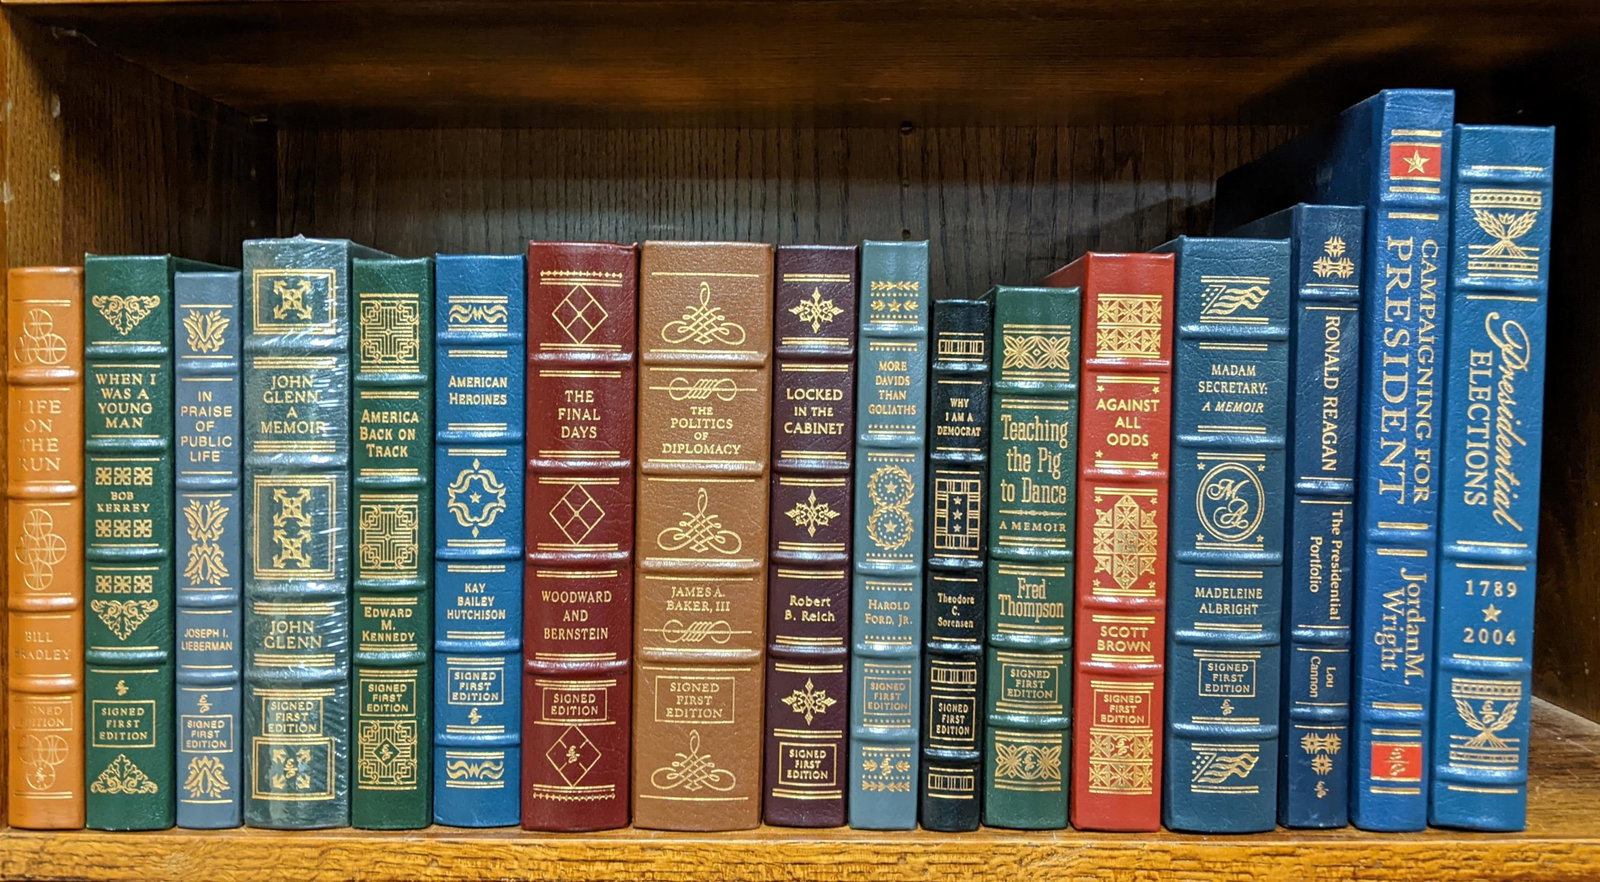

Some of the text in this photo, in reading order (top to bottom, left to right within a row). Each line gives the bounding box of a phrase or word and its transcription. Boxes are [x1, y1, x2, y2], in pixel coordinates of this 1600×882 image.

[879, 361, 907, 372] MORE
[1211, 365, 1256, 377] MADAM
[1379, 236, 1413, 505] PRESIDENT
[1413, 239, 1439, 503] CAMPAIGNING FOR
[96, 374, 156, 385] WHEN I
[271, 375, 314, 390] JOHN
[448, 376, 508, 388] AMERICAN
[875, 375, 910, 386] DAVIDS
[101, 388, 149, 400] WAS A
[1198, 382, 1268, 395] SECRETARY:
[1321, 315, 1341, 472] RONALD REAGAN
[198, 391, 212, 402] IN
[263, 391, 319, 404] GLENN
[449, 393, 507, 405] HEROINES
[564, 390, 594, 403] THE
[786, 388, 843, 401] LOCKED
[879, 390, 907, 400] THAN
[98, 403, 153, 414] YOUNG
[950, 398, 969, 408] WHY
[1096, 399, 1160, 412] AGAINST
[1202, 402, 1264, 413] A MEMOIR
[181, 406, 233, 417] PRAISE
[286, 406, 298, 418] A
[558, 408, 601, 421] FINAL
[690, 406, 713, 416] THE
[794, 407, 834, 417] IN THE
[868, 404, 917, 415] GOLIATHS
[361, 409, 419, 424] AMERICA
[945, 412, 974, 422] I AM A
[1485, 311, 1531, 532] Presidential
[24, 419, 52, 432] ON
[105, 417, 143, 429] MAN
[195, 421, 215, 432] OF
[261, 421, 327, 434] MEMOIR
[670, 418, 733, 429] POLITICS
[784, 422, 844, 435] CABINET
[1115, 417, 1141, 429] ALL
[1464, 349, 1493, 506] ELECTIONS
[360, 427, 416, 440] BACK ON
[561, 426, 597, 439] DAYS
[694, 432, 708, 440] OF
[937, 425, 981, 437] DEMOCRAT
[1001, 414, 1068, 449] Teaching
[181, 436, 232, 448] PUBLIC
[1106, 433, 1149, 447] ODDS
[366, 444, 408, 457] TRACK
[662, 443, 741, 455] DIPLOMACY
[190, 451, 221, 463] LIFE
[1006, 446, 1061, 480] the Pig
[111, 492, 134, 500] BOB
[1001, 477, 1067, 504] to Dance
[97, 504, 150, 513] KERREY
[999, 521, 1067, 532] A MEMOIR
[1310, 535, 1323, 593] Portfolio
[1329, 509, 1344, 621] The Presidential
[464, 583, 486, 593] KAY
[671, 587, 726, 598] JAMES A.
[1017, 578, 1046, 600] Fred
[1195, 587, 1263, 599] MADELEINE
[1465, 580, 1517, 597] 1789
[457, 596, 494, 607] BAILEY
[541, 590, 612, 603] WOODWARD
[789, 595, 831, 607] Robert
[937, 593, 975, 604] Theodore
[666, 600, 730, 613] BAKER, III
[868, 599, 910, 611] HAROLD
[998, 594, 1064, 623] Thompson
[1199, 603, 1258, 615] ALBRIGHT
[364, 607, 413, 618] EDWARD
[447, 609, 506, 620] HUTCHISON
[563, 609, 588, 622] AND
[784, 610, 836, 622] B. Reich
[951, 606, 960, 616] C.
[269, 621, 315, 635] JOHN
[381, 620, 396, 630] M.
[937, 617, 974, 629] Sorensen
[184, 628, 229, 638] JOSEPH I.
[544, 628, 608, 640] BERNSTEIN
[1100, 626, 1149, 638] SCOTT
[1374, 587, 1405, 671] Wright
[25, 631, 53, 643] BILL
[264, 635, 322, 649] GLENN
[362, 631, 415, 642] KENNEDY
[1463, 628, 1517, 645] 2004
[181, 641, 233, 651] LIEBERMAN
[1097, 640, 1151, 652] BROWN
[1207, 663, 1249, 672] SIGNED
[454, 672, 496, 681] SIGNED
[1010, 668, 1051, 679] SIGNED
[1212, 673, 1244, 682] FIRST
[1309, 656, 1322, 698] Cannon
[1325, 666, 1337, 688] Lou
[368, 683, 407, 693] SIGNED
[459, 682, 491, 691] FIRST
[670, 682, 720, 693] SIGNED
[870, 682, 905, 691] SIGNED
[1015, 679, 1046, 689] FIRST
[1205, 683, 1250, 693] EDITION
[372, 693, 402, 703] FIRST
[452, 692, 499, 701] EDITION
[553, 693, 596, 703] SIGNED
[874, 692, 901, 700] FIRST
[1007, 688, 1053, 699] EDITION
[1103, 694, 1142, 704] SIGNED
[270, 701, 314, 711] SIGNED
[676, 695, 713, 706] FIRST
[867, 702, 908, 710] EDITION
[101, 707, 144, 716] SIGNED
[367, 703, 408, 713] EDITION
[551, 706, 598, 716] EDITION
[666, 708, 723, 718] EDITION
[938, 703, 969, 713] SIGNED
[1109, 704, 1137, 714] FIRST
[275, 713, 309, 722] FIRST
[941, 714, 965, 724] FIRST
[1100, 714, 1145, 724] EDITION
[106, 719, 140, 729] FIRST
[187, 720, 225, 729] SIGNED
[268, 723, 317, 733] EDITION
[936, 724, 970, 735] EDITION
[99, 731, 148, 740] EDITION
[191, 729, 220, 739] FIRST
[186, 739, 227, 749] EDITION
[789, 749, 827, 759] SIGNED
[795, 759, 821, 769] FIRST
[786, 769, 828, 780] EDITION
